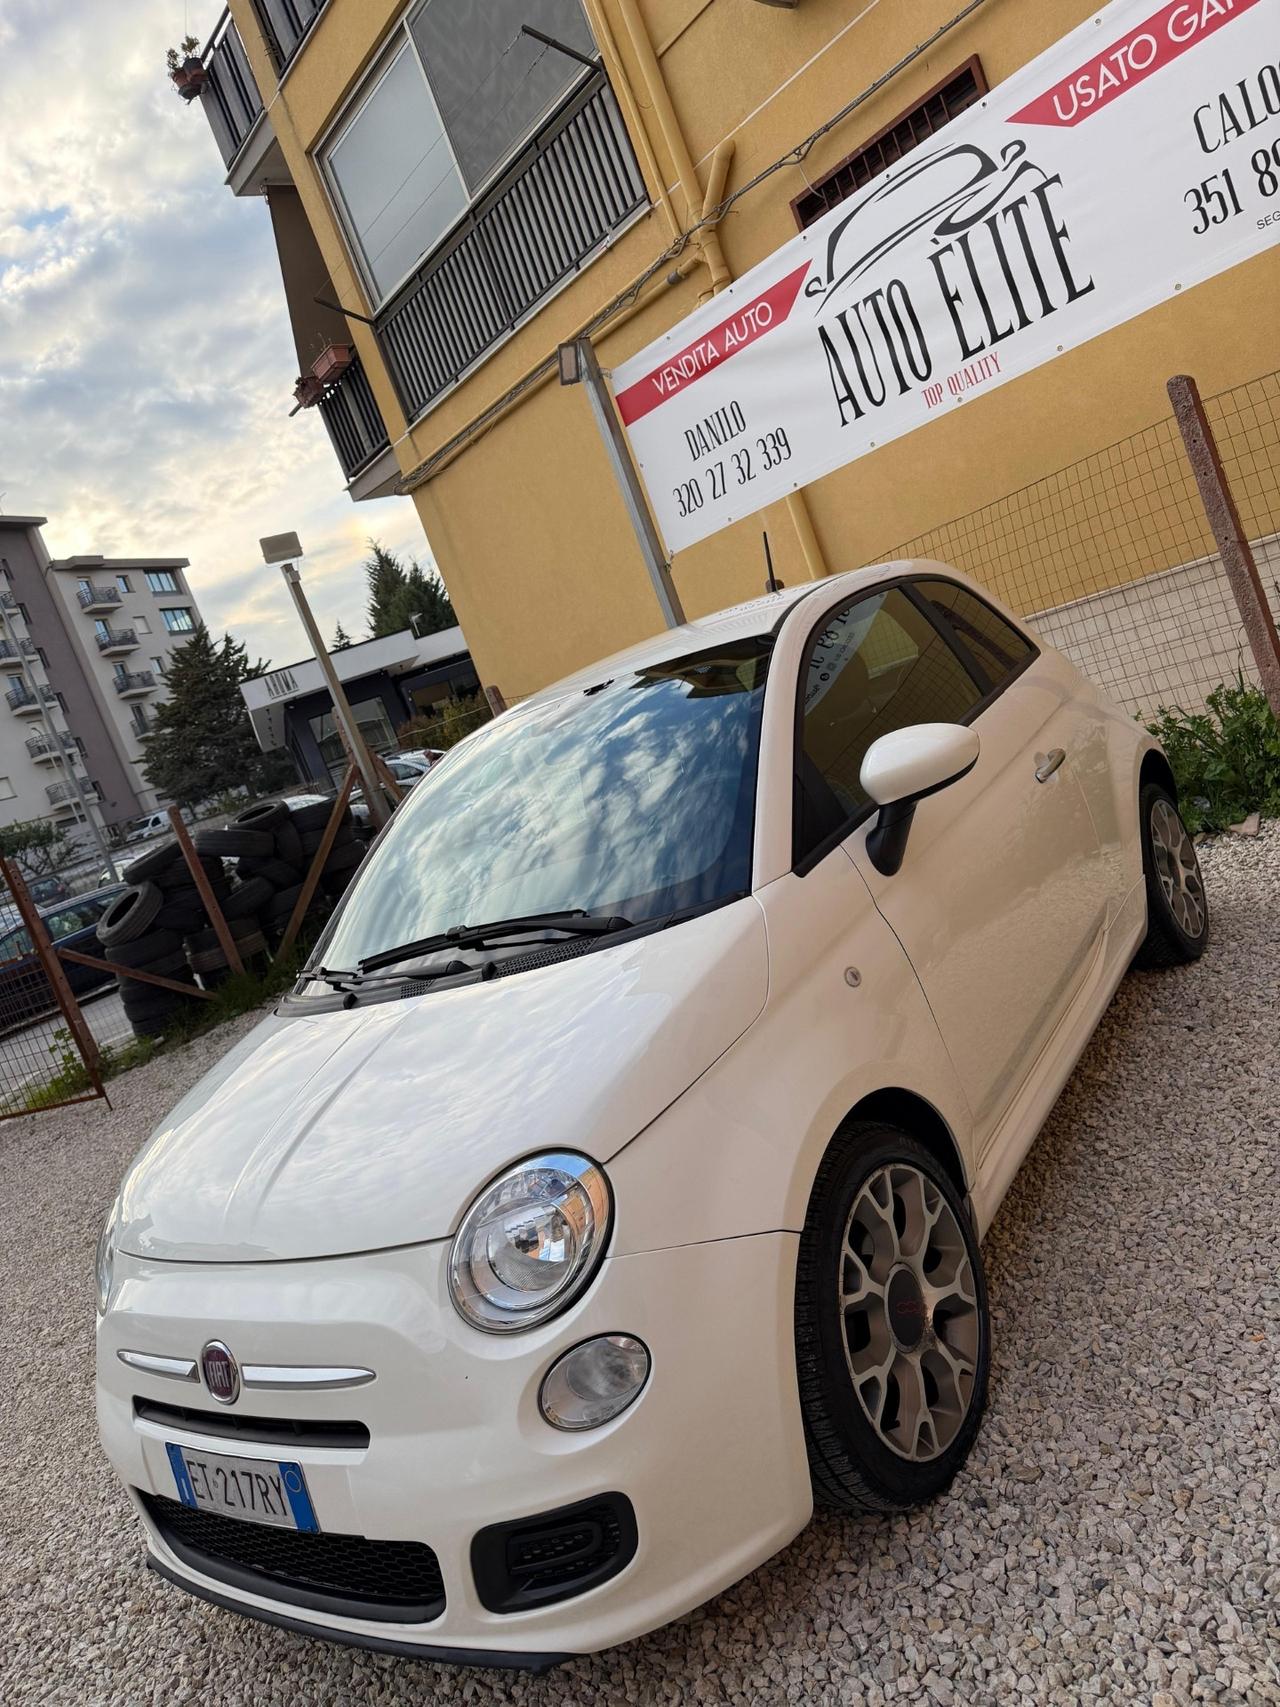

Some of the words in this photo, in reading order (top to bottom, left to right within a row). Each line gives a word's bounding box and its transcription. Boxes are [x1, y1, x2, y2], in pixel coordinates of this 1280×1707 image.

[1052, 33, 1158, 121] USATO
[1167, 0, 1235, 43] GA
[1193, 62, 1280, 154] CALO
[1183, 168, 1246, 235] 351
[652, 340, 720, 395] VENDITA
[725, 301, 773, 352] AUTO
[817, 278, 933, 428] AUTO
[921, 383, 945, 408] TOP
[947, 353, 1002, 395] QUALITY
[683, 400, 747, 462] DANILO
[673, 478, 704, 518] 320
[705, 461, 729, 500] 27
[730, 447, 757, 485] 32
[756, 427, 792, 471] 339
[208, 1360, 230, 1388] FIAT
[186, 1460, 214, 1501] ET
[216, 1467, 288, 1517] 217RY
